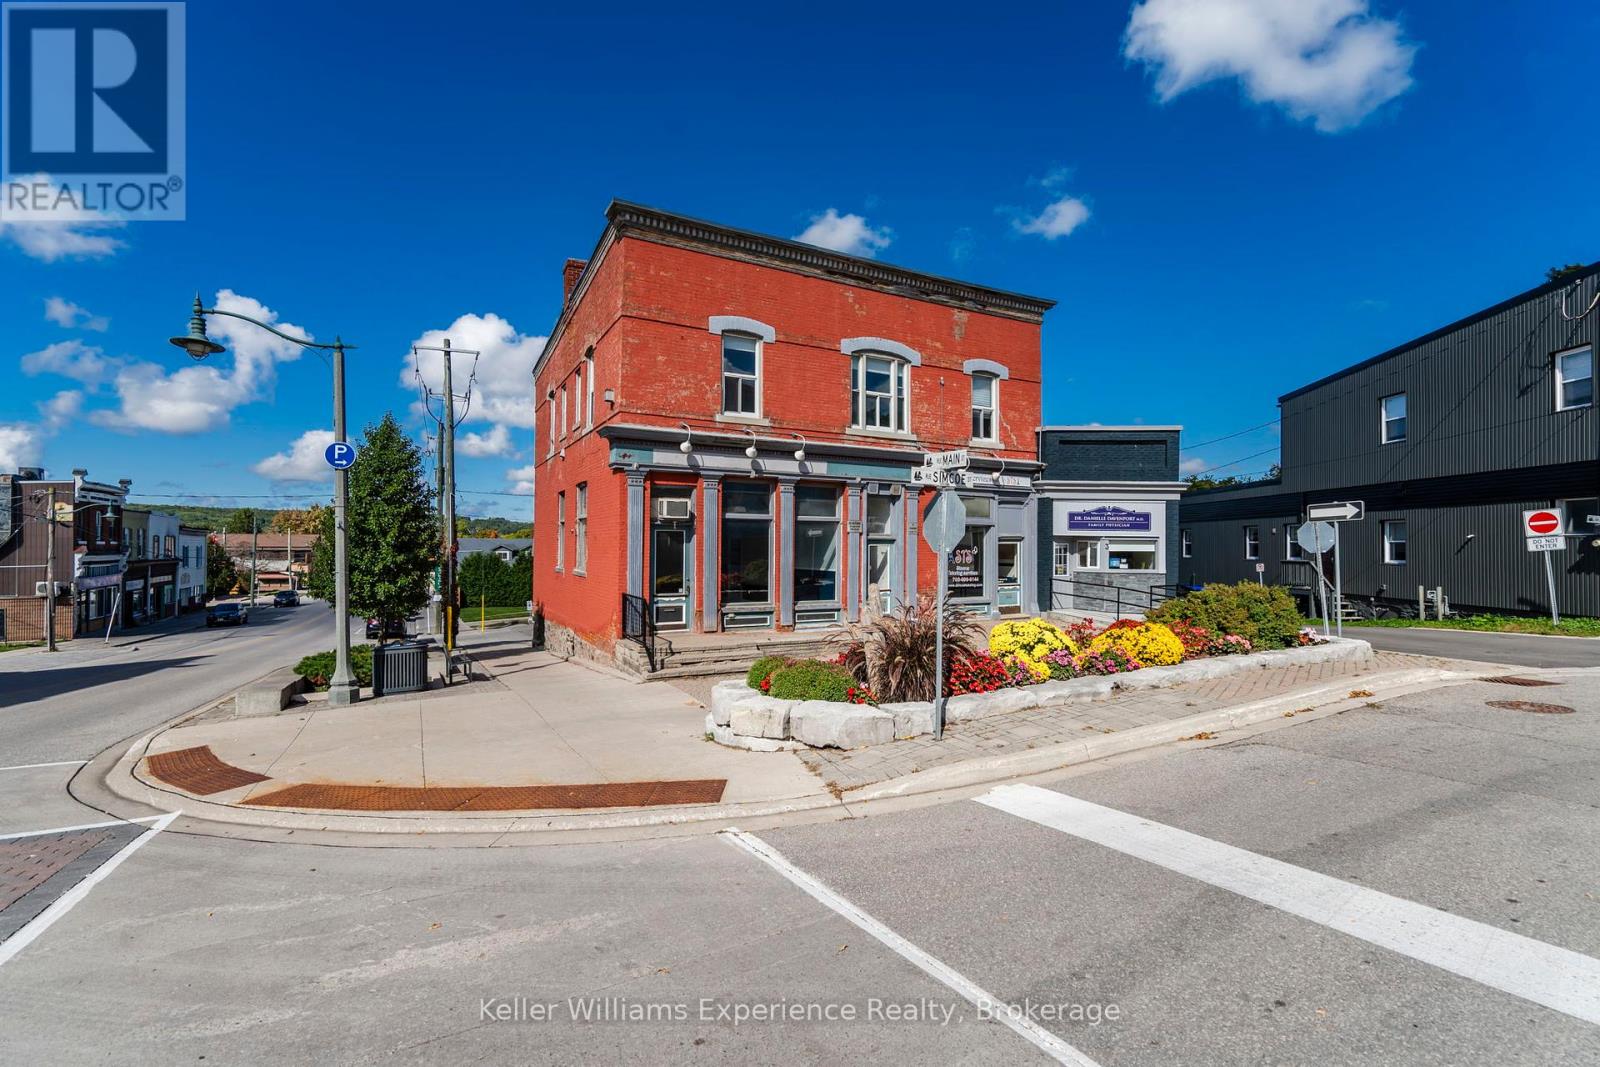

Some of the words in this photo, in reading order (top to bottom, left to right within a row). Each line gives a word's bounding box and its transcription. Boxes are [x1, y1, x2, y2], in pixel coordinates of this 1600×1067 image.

[335, 445, 347, 459] P
[942, 452, 960, 466] MAIN
[933, 470, 966, 486] SIMCOE
